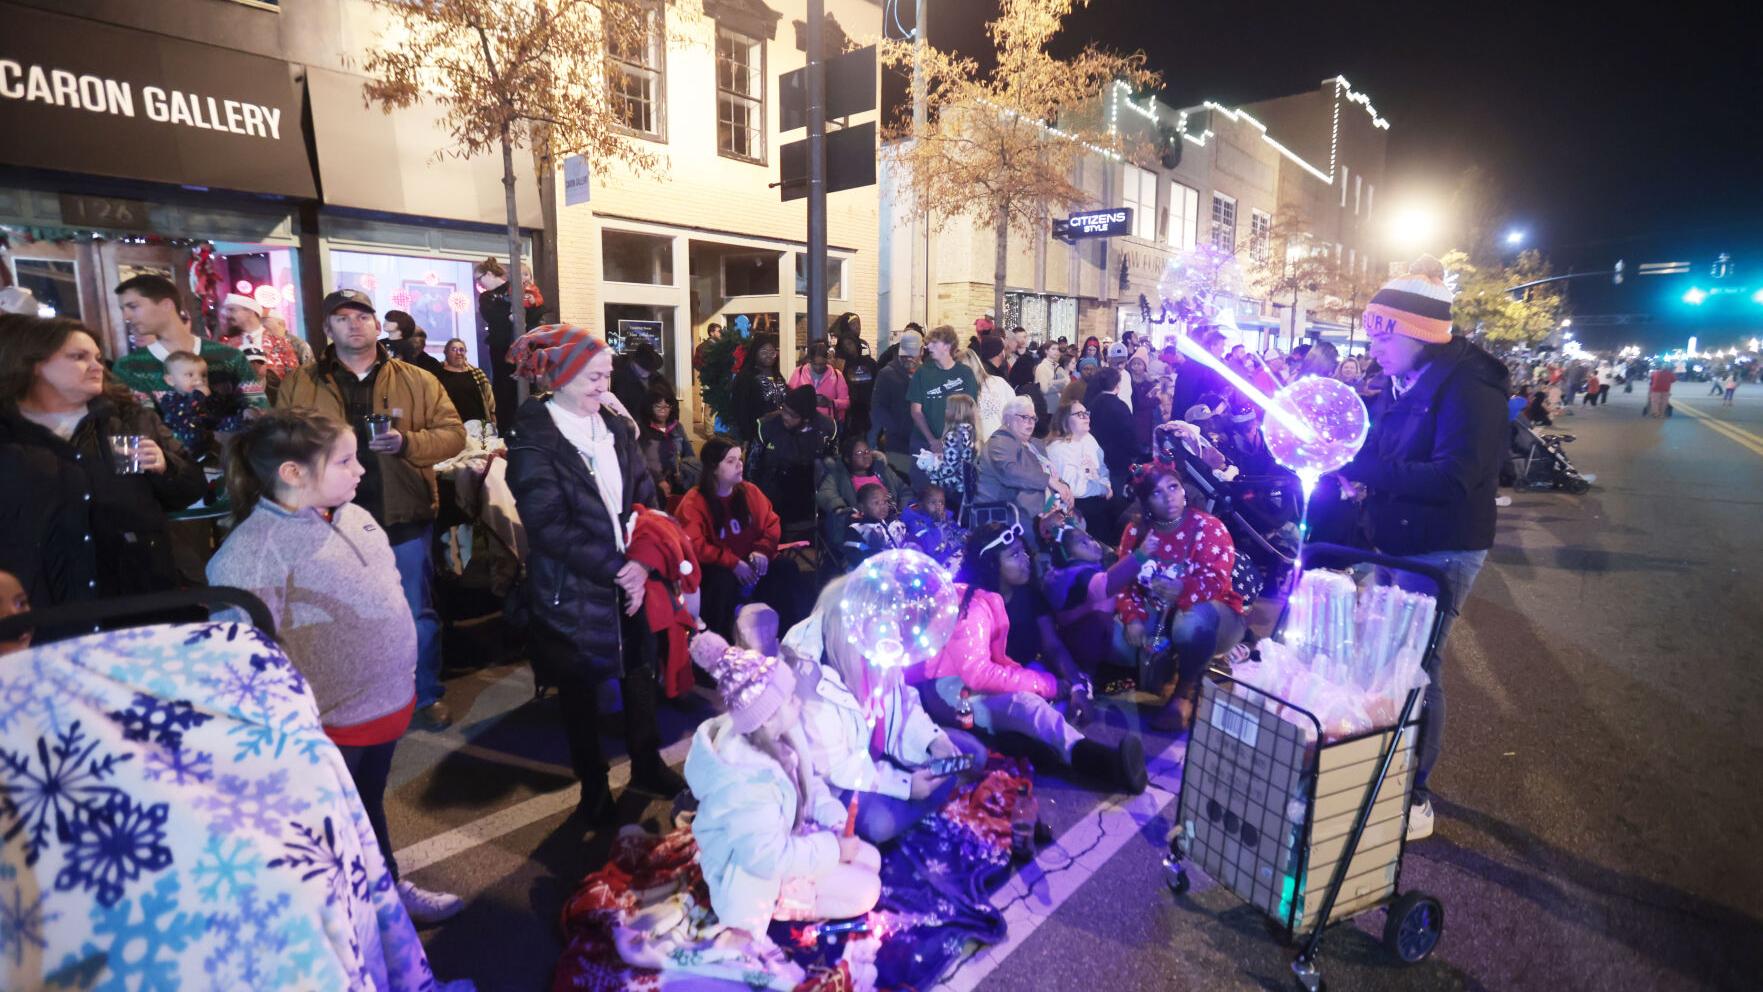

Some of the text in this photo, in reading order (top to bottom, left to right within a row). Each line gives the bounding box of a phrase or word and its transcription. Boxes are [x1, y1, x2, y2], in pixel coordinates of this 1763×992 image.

[0, 59, 281, 140] CARON GALLERY
[1070, 212, 1126, 227] CITIZENS
[1083, 224, 1108, 233] STYLE
